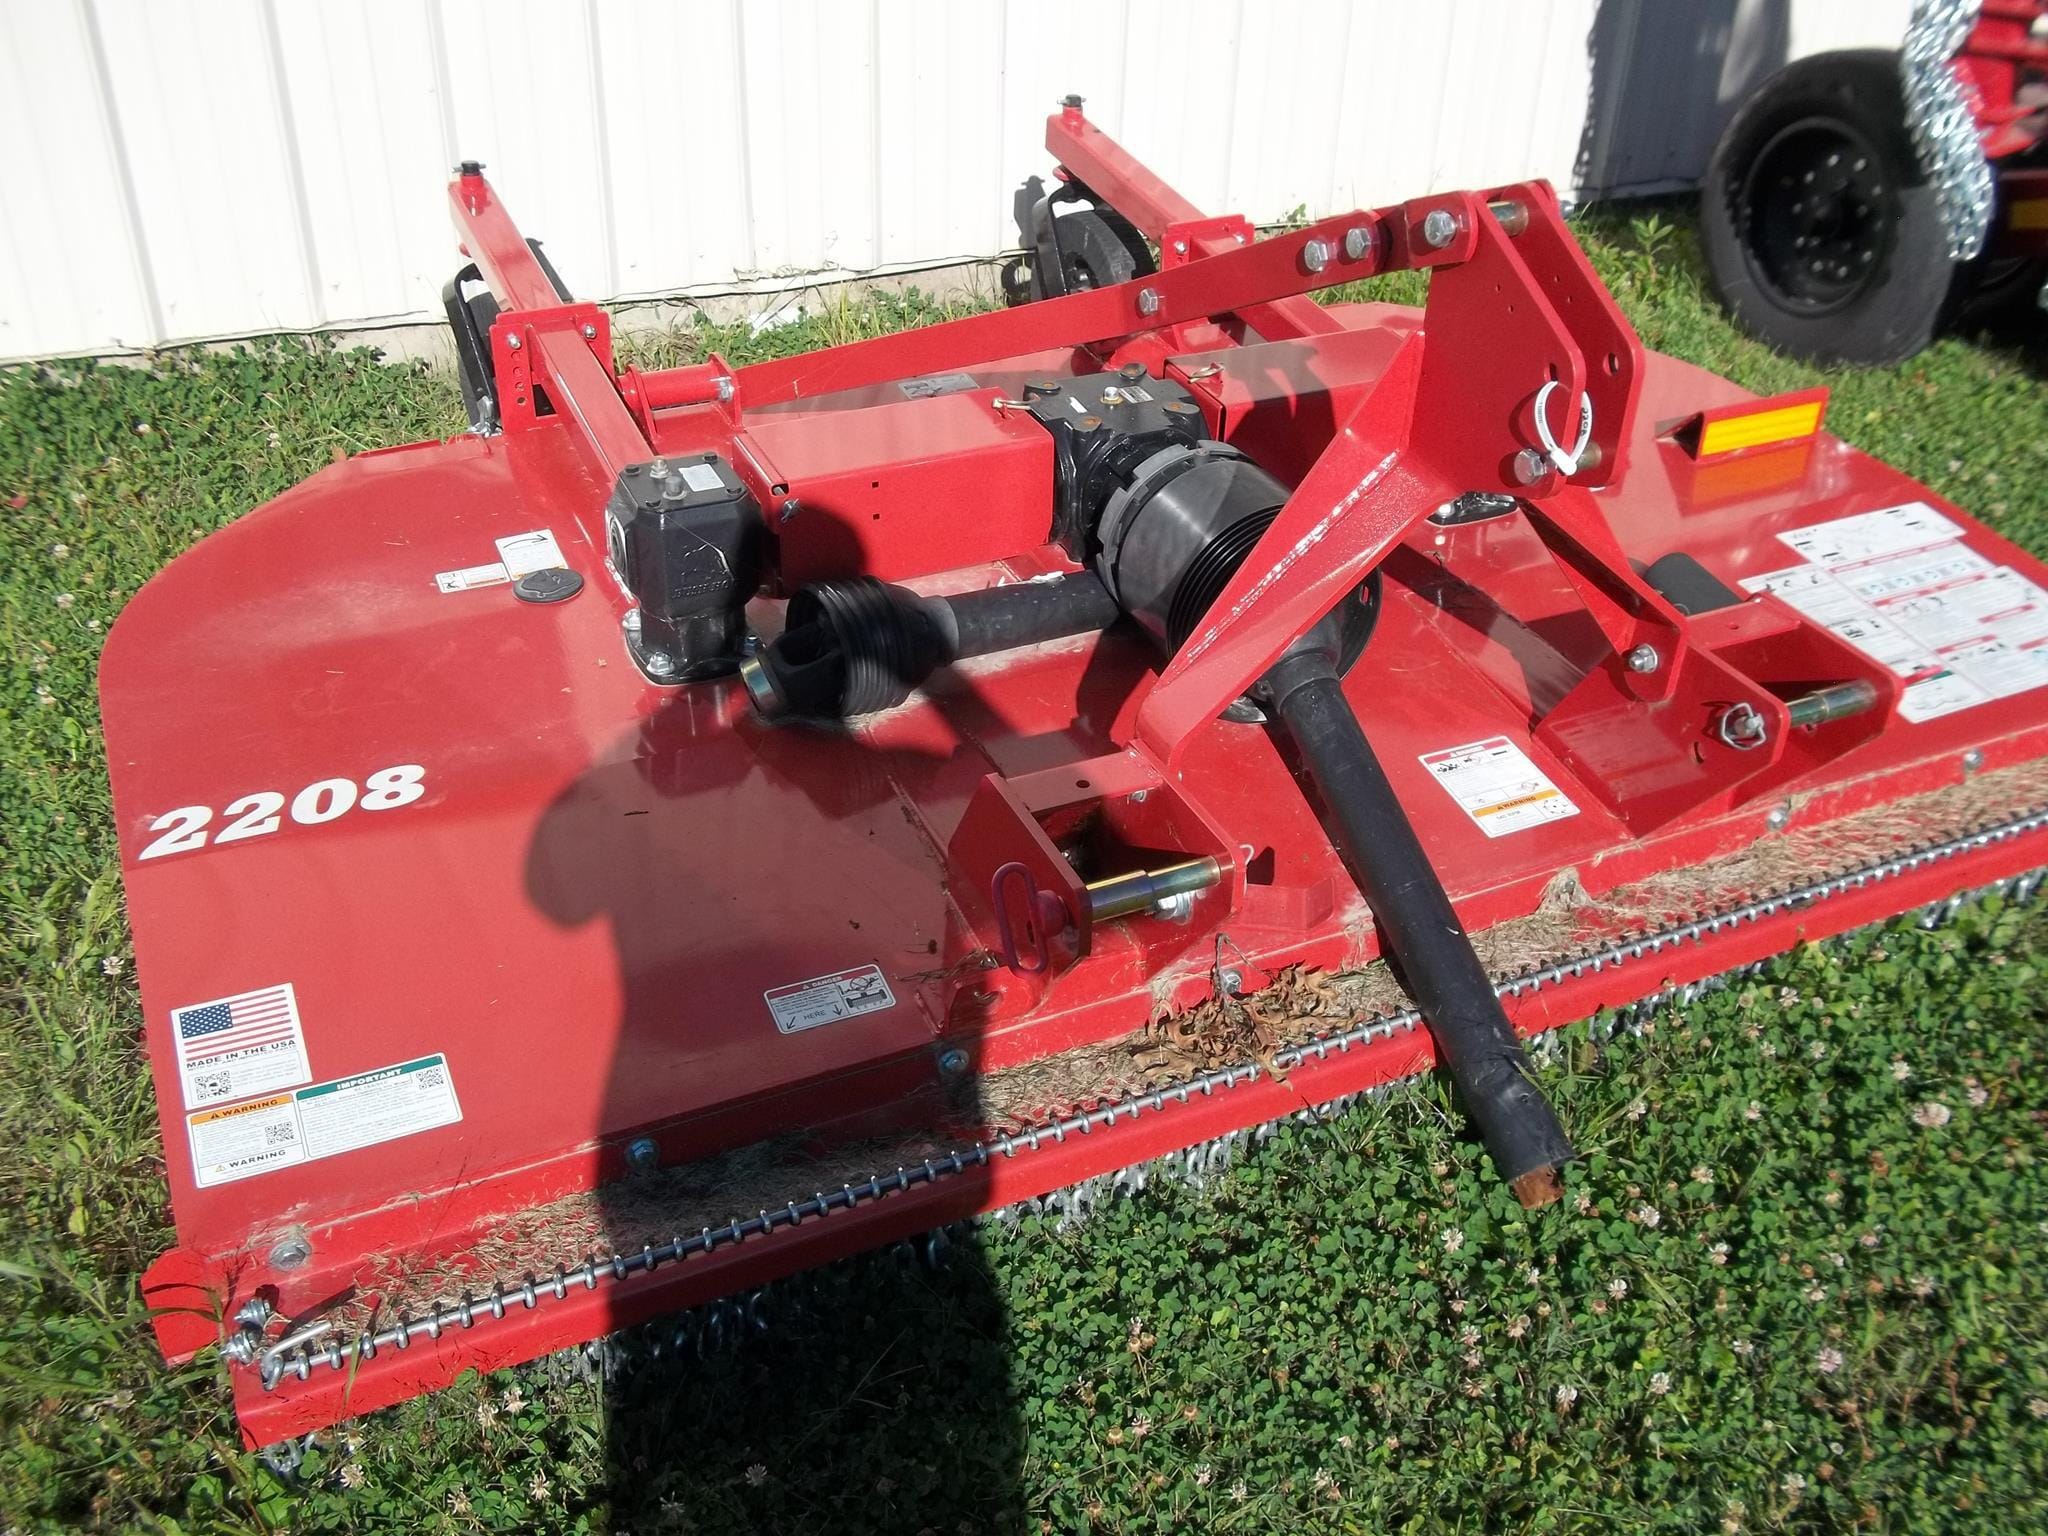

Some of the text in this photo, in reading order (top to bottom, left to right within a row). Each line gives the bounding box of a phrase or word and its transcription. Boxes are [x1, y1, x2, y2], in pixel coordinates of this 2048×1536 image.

[138, 764, 426, 861] 2208
[811, 976, 843, 988] DANGER
[803, 1009, 826, 1020] HERE
[186, 1040, 295, 1068] MADE IN THE USA
[336, 1068, 402, 1090] IMPORTANT
[222, 1099, 279, 1117] WARNING
[229, 1149, 286, 1168] WARNING
